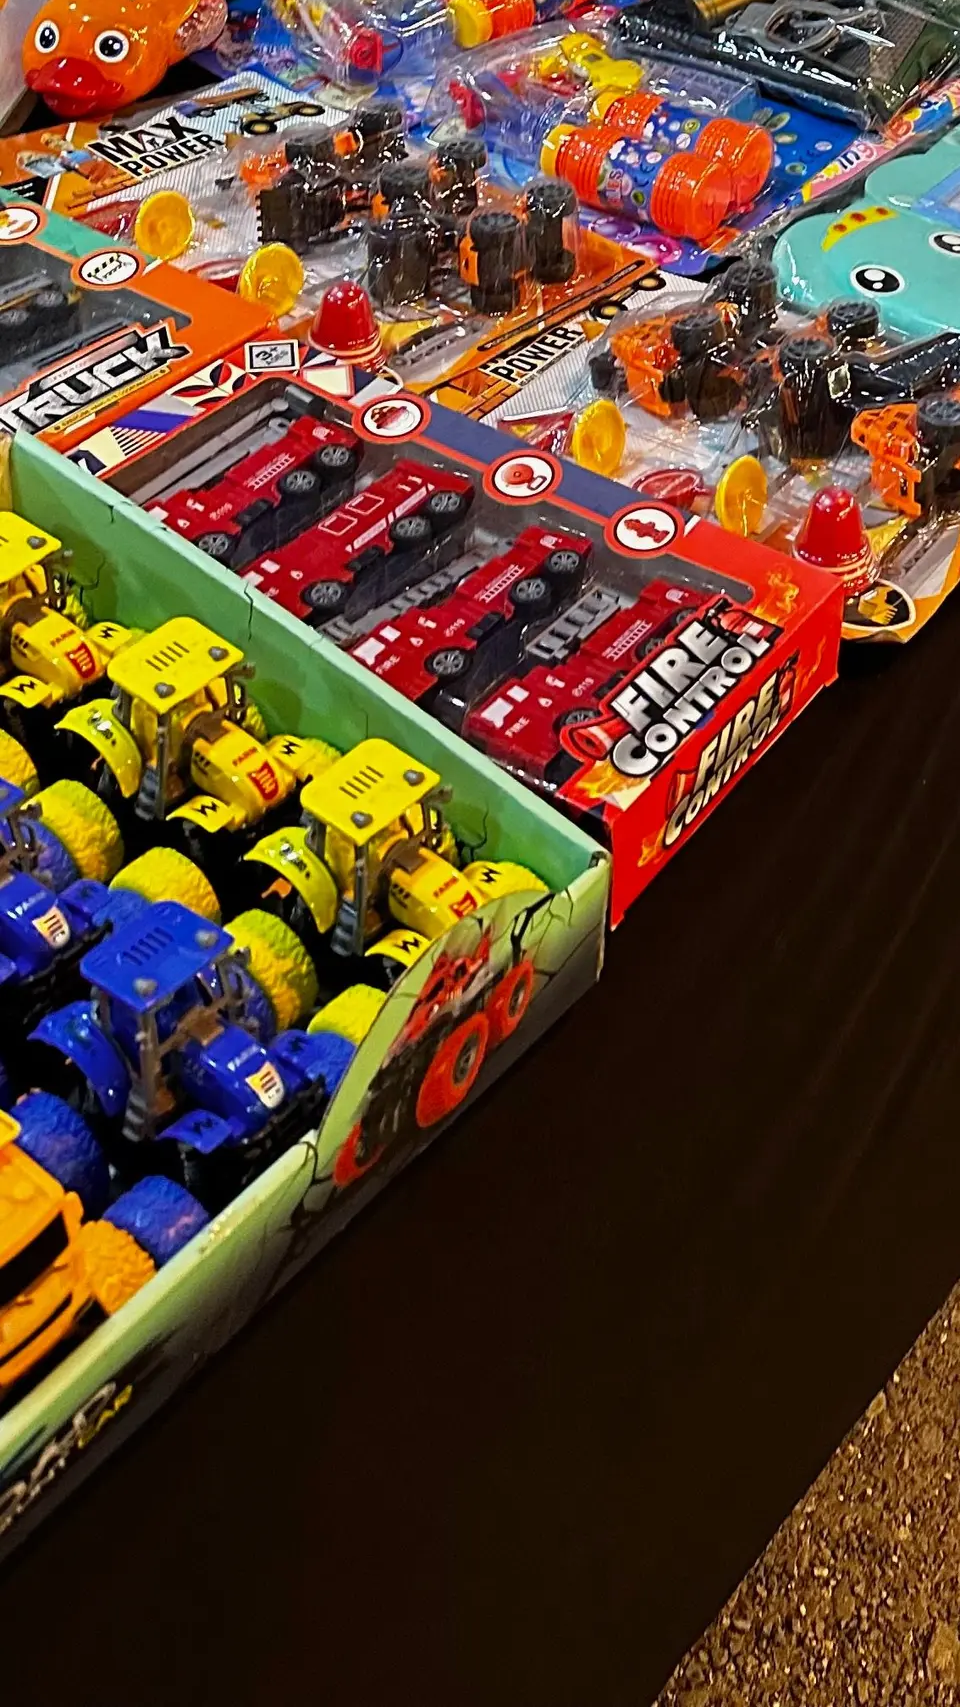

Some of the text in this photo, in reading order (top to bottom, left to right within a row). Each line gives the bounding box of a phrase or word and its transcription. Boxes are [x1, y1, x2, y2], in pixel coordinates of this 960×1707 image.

[88, 117, 203, 165] MAX
[120, 132, 227, 178] POWER
[489, 325, 584, 383] POWER
[610, 620, 728, 733] FIRE
[612, 632, 771, 775] CONTROL
[694, 671, 777, 791] FIRE
[664, 705, 781, 846] CONTROL
